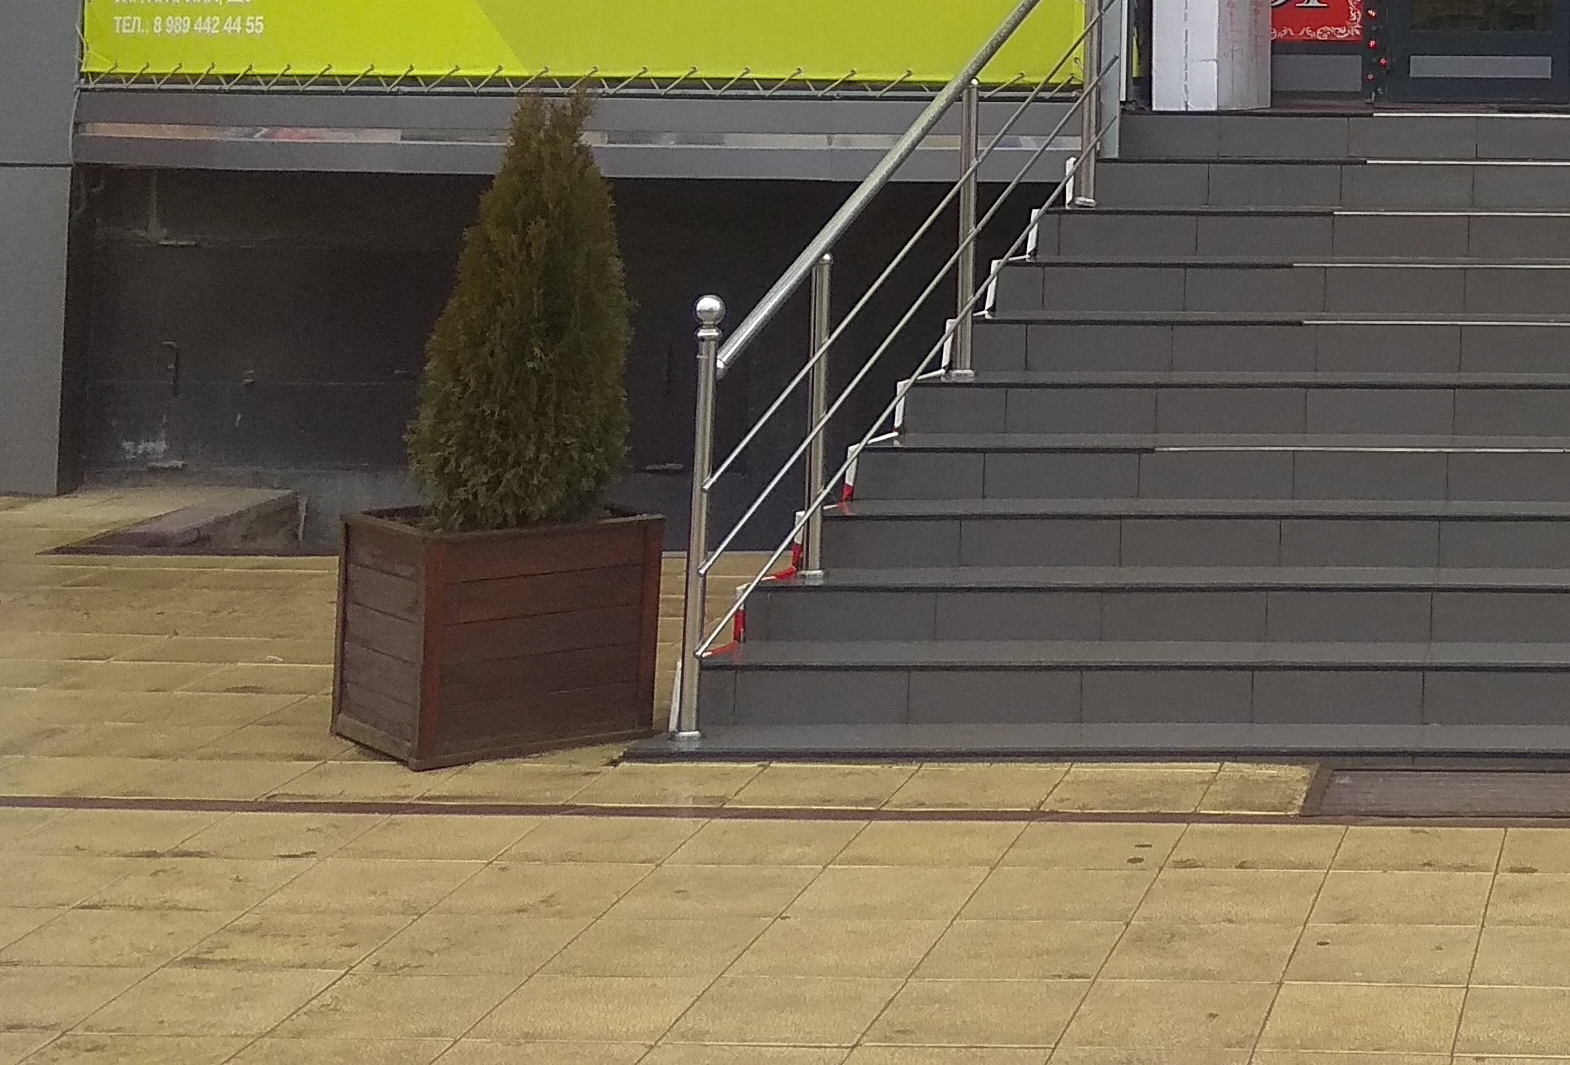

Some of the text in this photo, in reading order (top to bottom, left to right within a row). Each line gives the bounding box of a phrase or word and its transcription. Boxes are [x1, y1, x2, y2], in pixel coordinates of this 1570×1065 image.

[153, 15, 162, 34] 8
[165, 15, 191, 34] 989
[193, 15, 220, 34] 442
[223, 15, 243, 34] 44
[245, 15, 264, 34] 55
